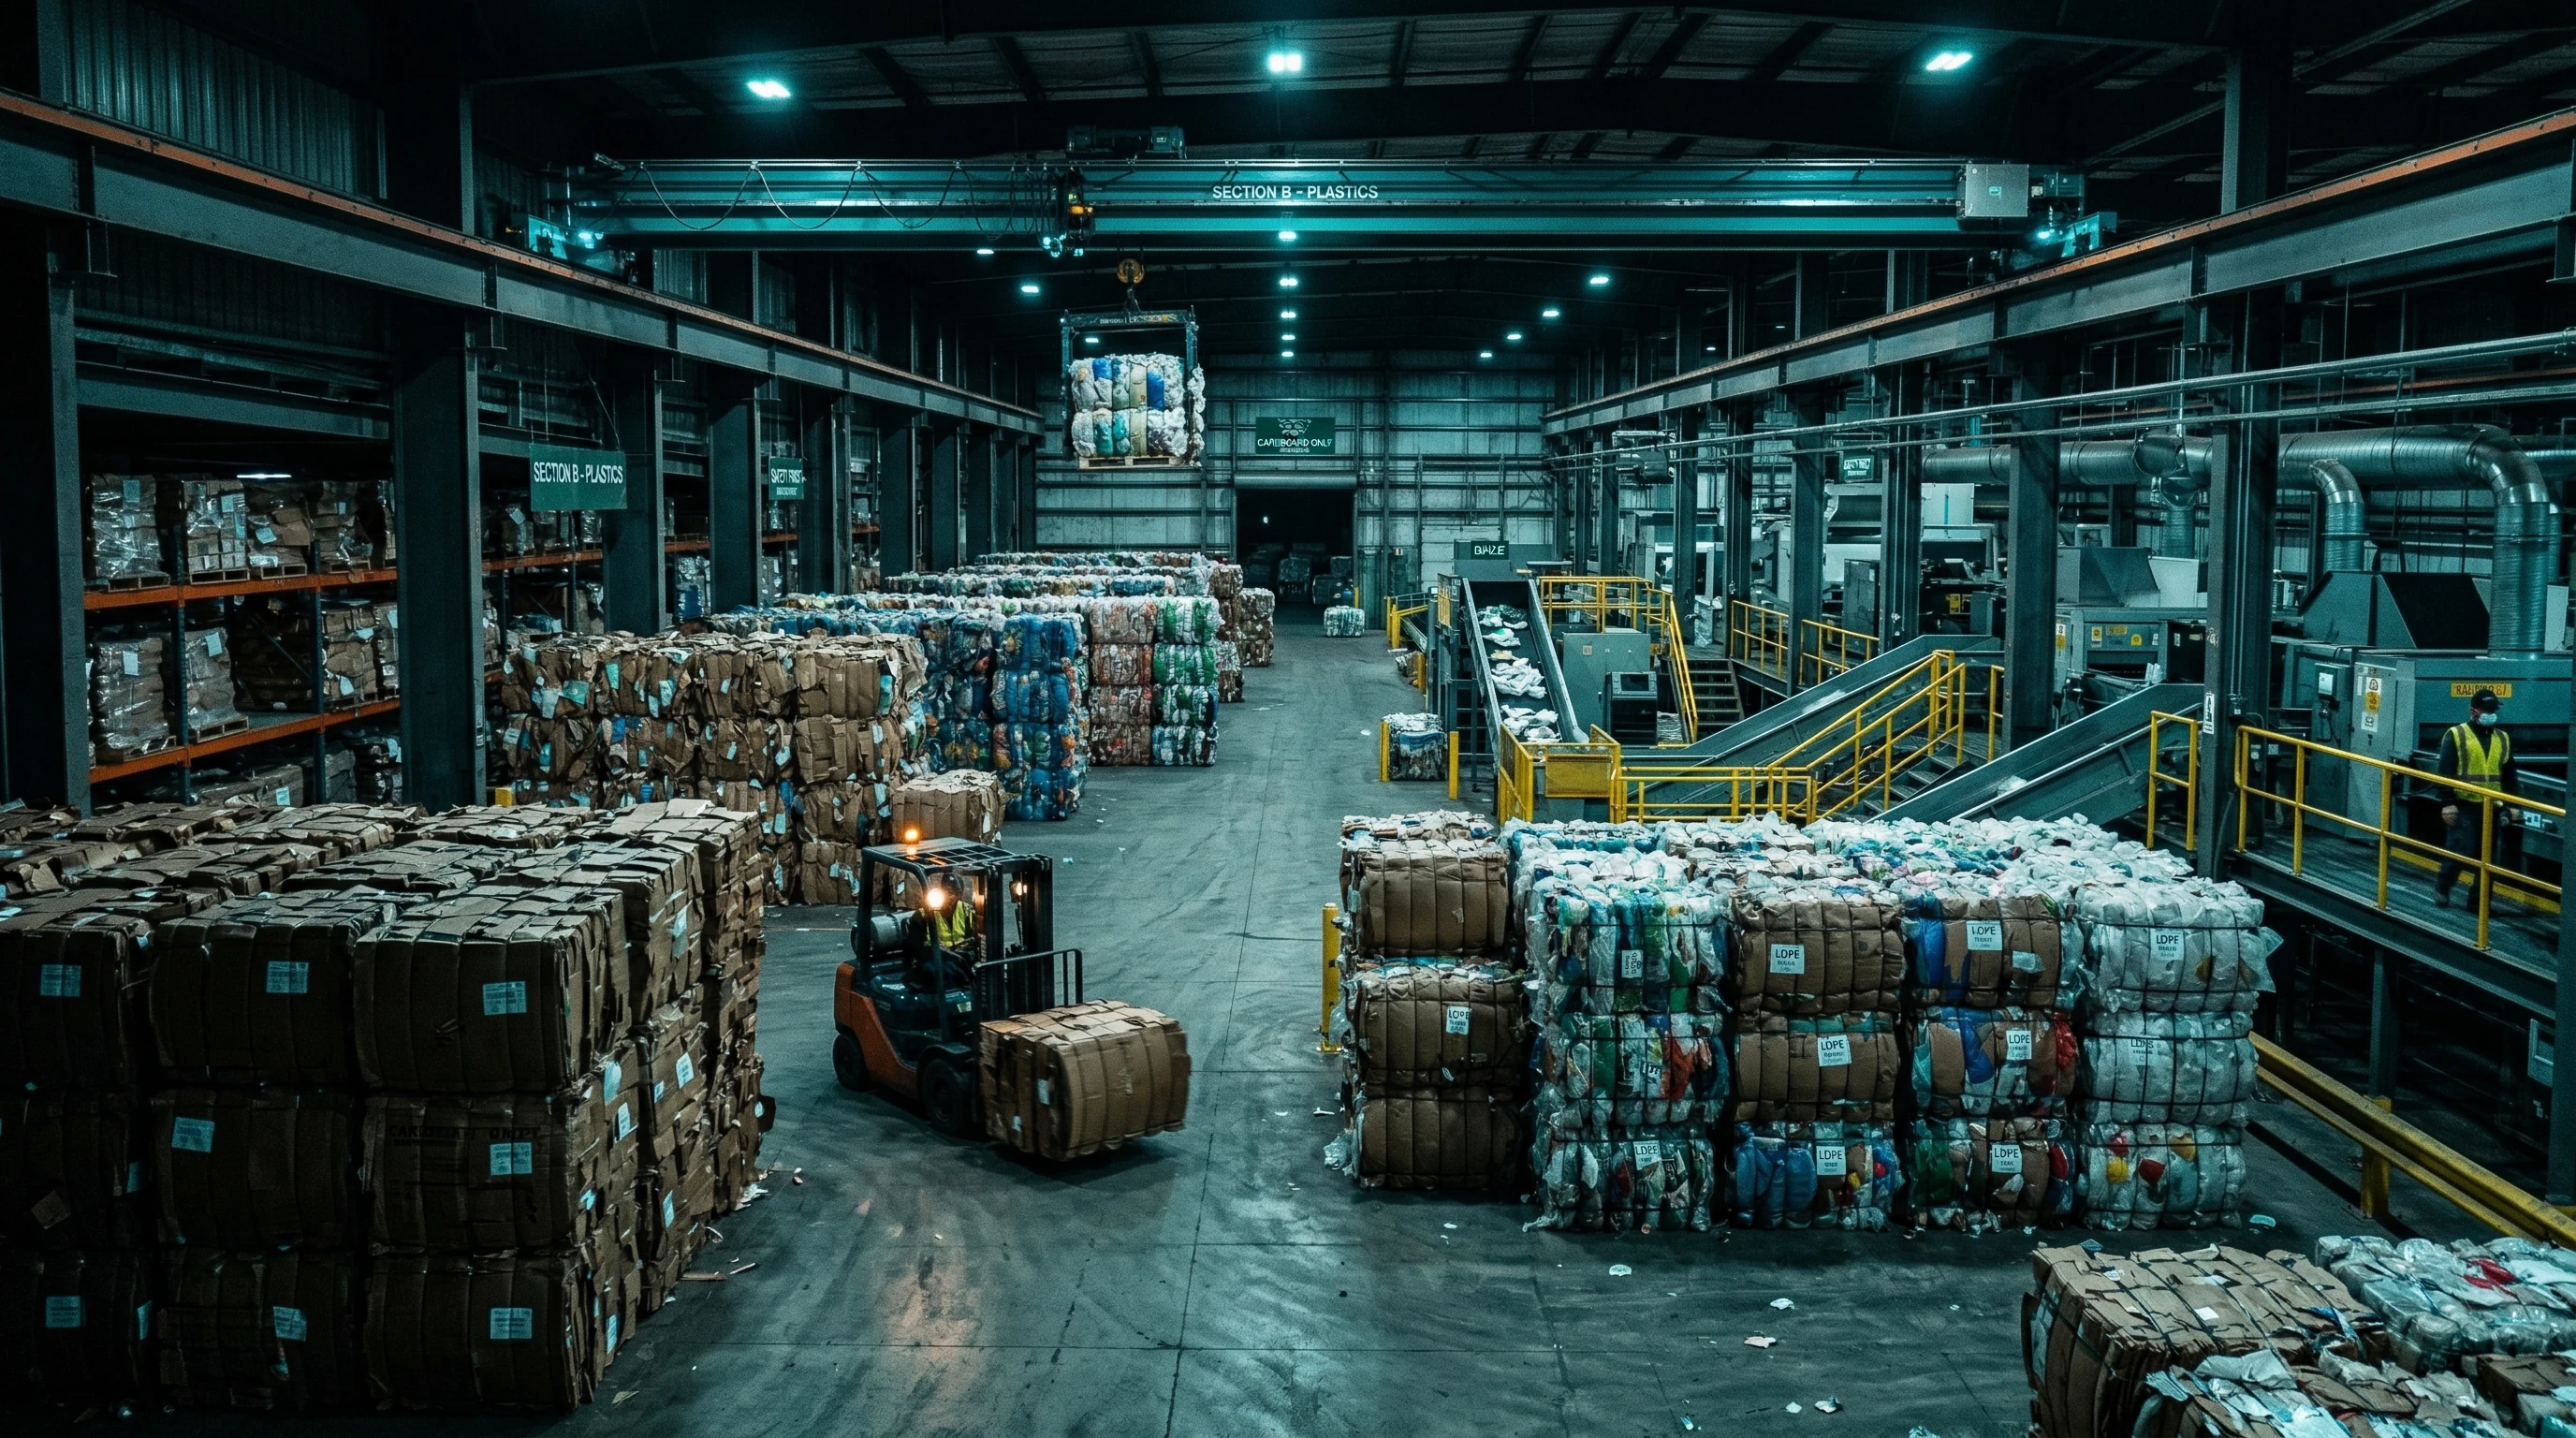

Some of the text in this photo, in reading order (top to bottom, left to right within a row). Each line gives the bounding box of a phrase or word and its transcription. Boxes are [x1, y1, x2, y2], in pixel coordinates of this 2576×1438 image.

[1212, 185, 1277, 198] SECTION
[1281, 185, 1292, 198] B
[1307, 185, 1378, 198] PLASTICS
[534, 462, 571, 482] SECTION
[572, 463, 579, 483] B
[585, 464, 623, 483] PLASTICS
[2156, 934, 2179, 945] LDPE
[1819, 1150, 1843, 1160] LDPE
